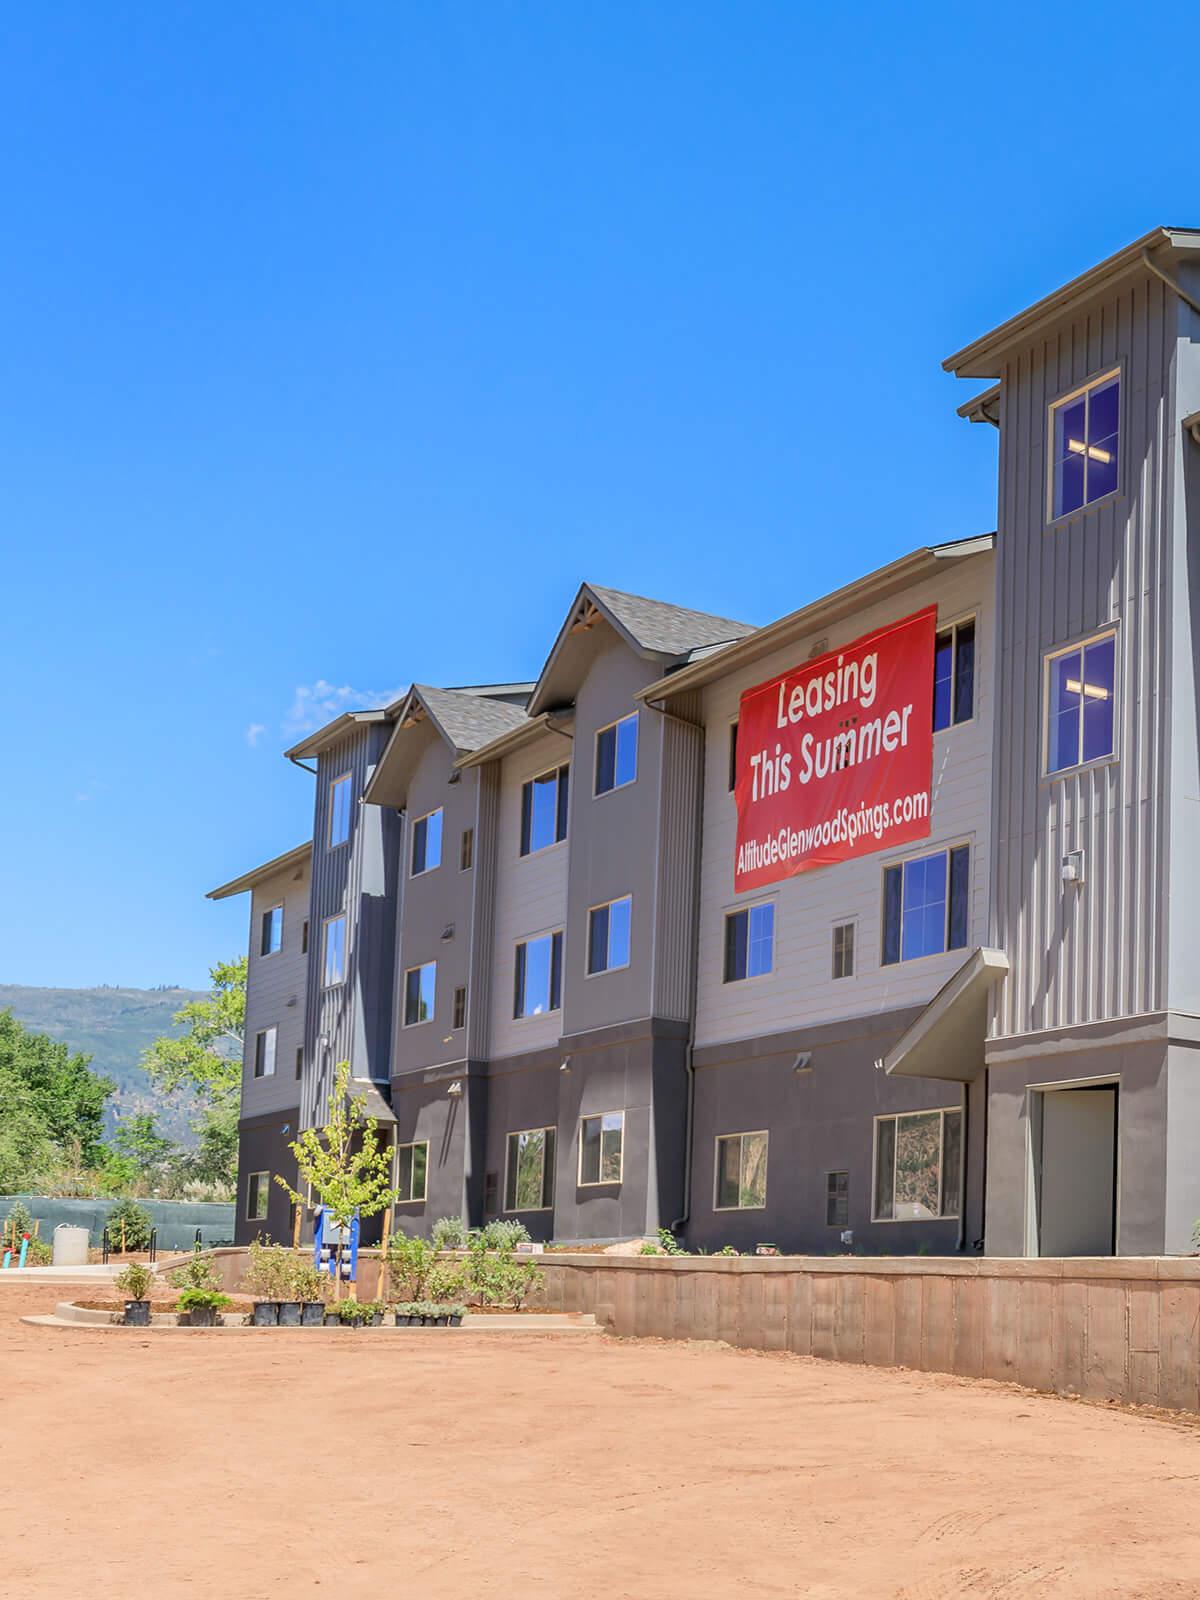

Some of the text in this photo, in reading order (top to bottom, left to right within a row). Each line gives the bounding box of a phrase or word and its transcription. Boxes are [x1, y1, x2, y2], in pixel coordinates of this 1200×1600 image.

[776, 652, 878, 729] Leasing
[750, 703, 913, 802] This Summer
[736, 791, 928, 875] AltitudeGlenwoodSprings.com
